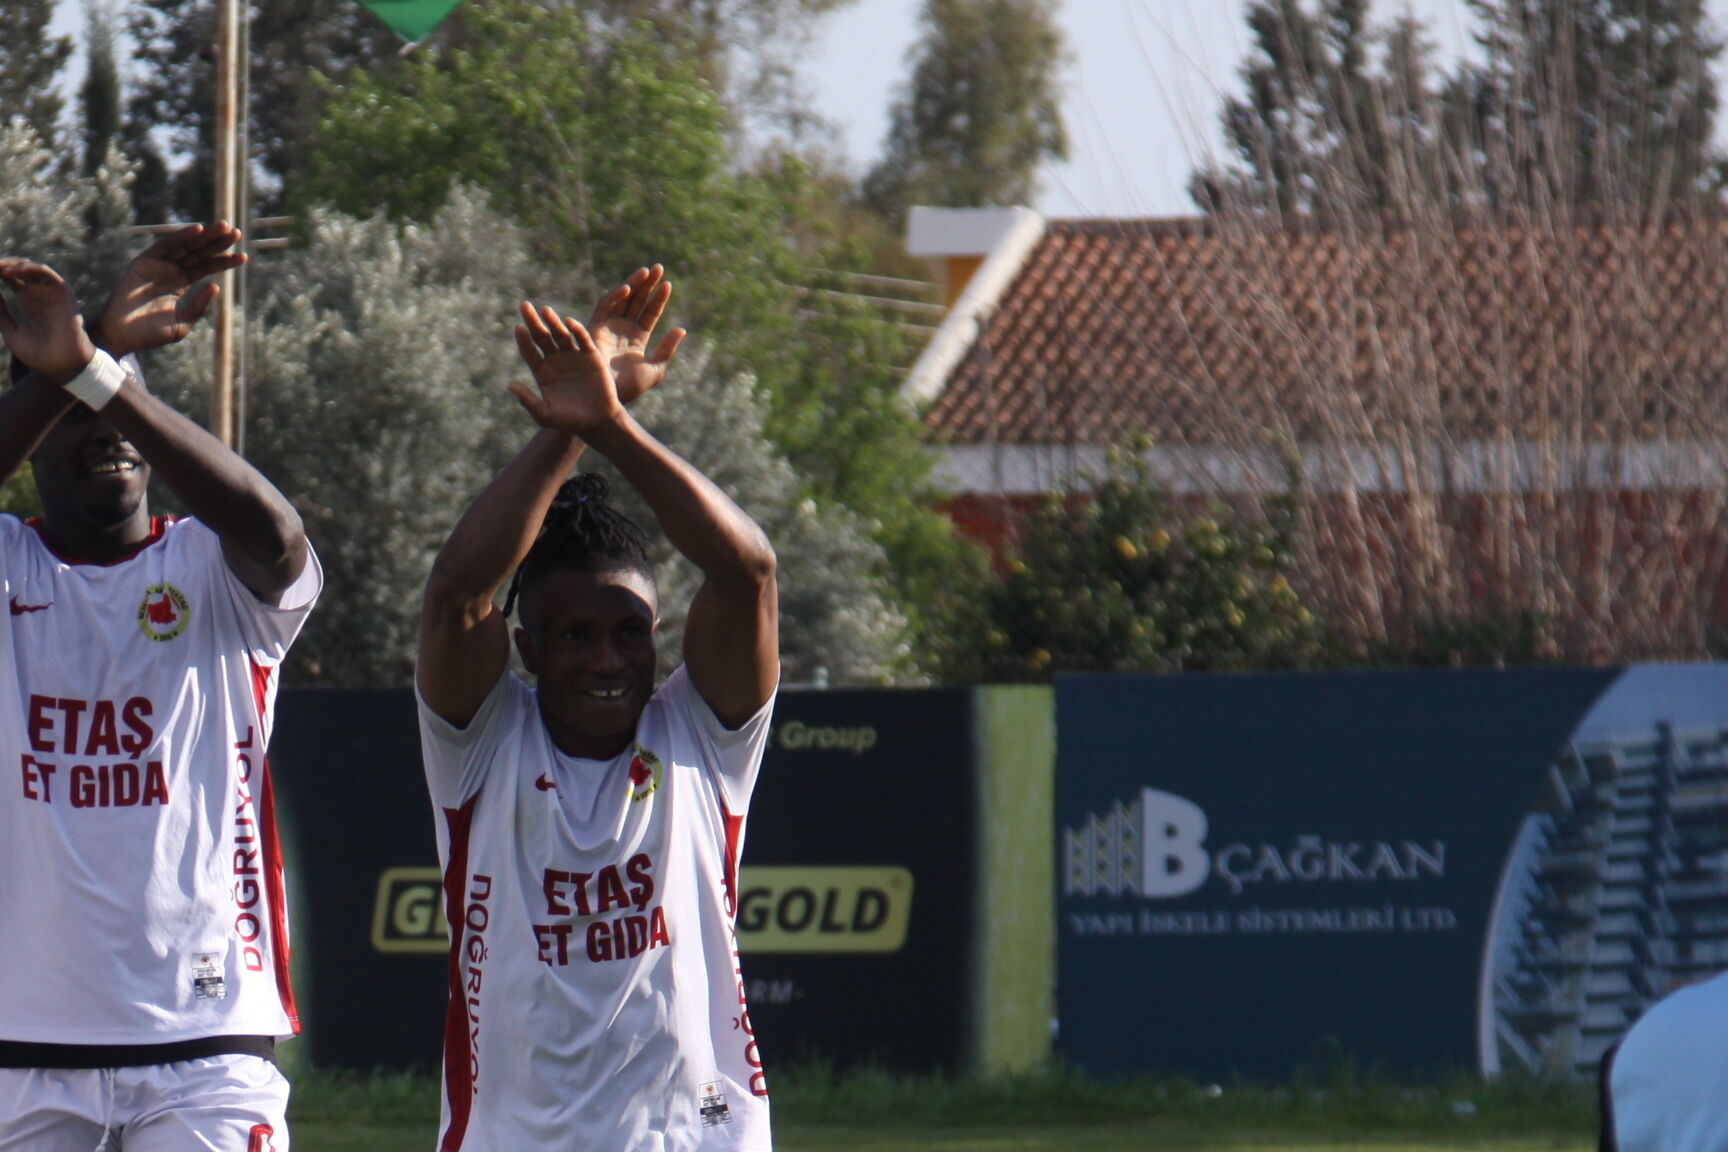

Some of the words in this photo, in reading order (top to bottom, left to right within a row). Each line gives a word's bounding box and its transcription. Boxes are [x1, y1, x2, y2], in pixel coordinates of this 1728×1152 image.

[28, 694, 153, 759] ETAŞ
[780, 720, 877, 754] Group
[21, 754, 56, 803] ET
[69, 761, 169, 808] GIDA
[228, 725, 263, 972] DOĞRUYOL
[1216, 834, 1445, 895] ÇAĞKAN
[394, 886, 449, 935] G
[736, 886, 890, 934] GOLD
[543, 853, 654, 913] ETAŞ
[534, 924, 572, 967] ET
[587, 905, 670, 963] GIDA
[1070, 912, 1133, 935] YAPI
[750, 977, 794, 1004] RM
